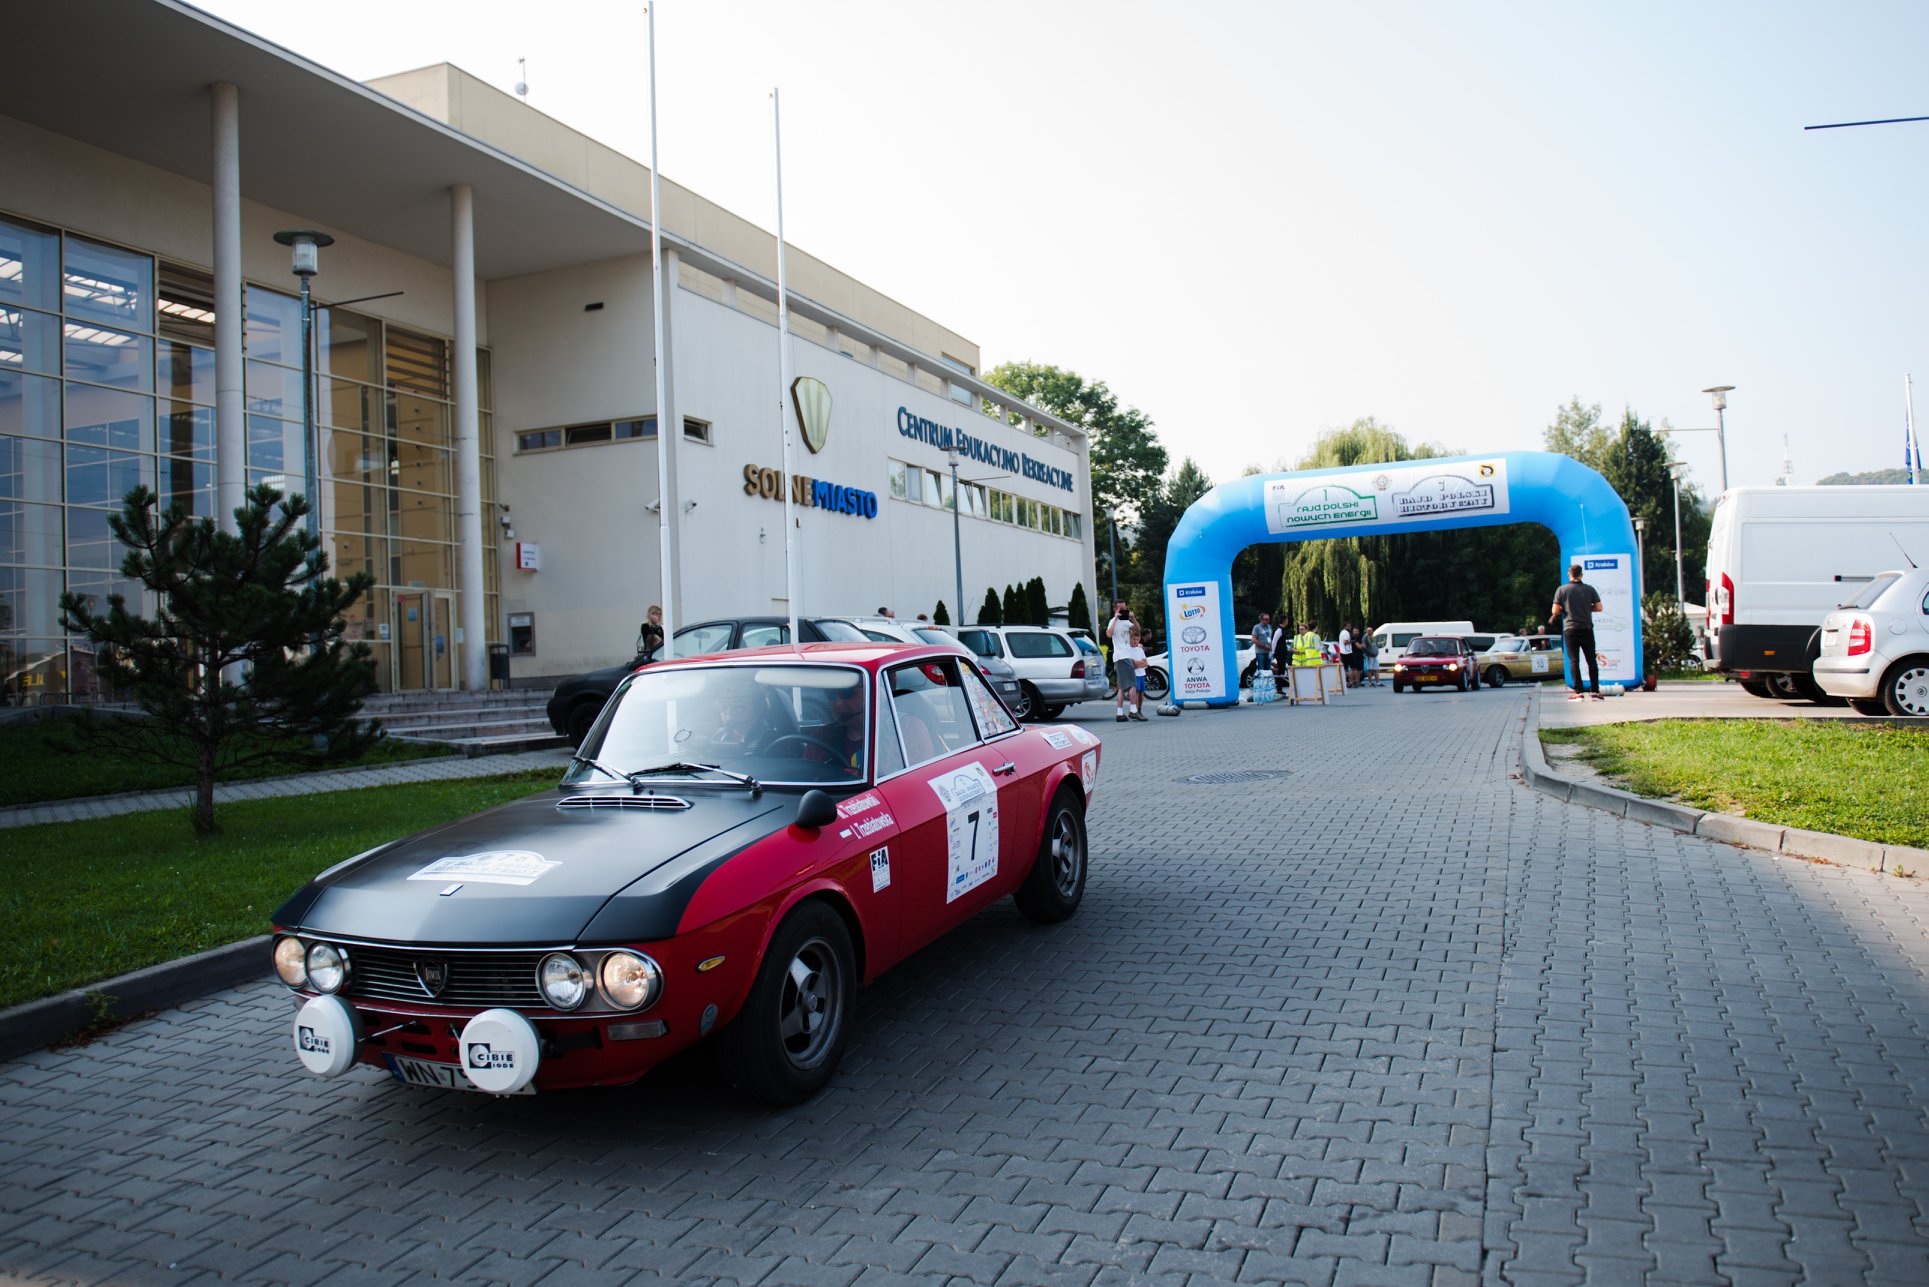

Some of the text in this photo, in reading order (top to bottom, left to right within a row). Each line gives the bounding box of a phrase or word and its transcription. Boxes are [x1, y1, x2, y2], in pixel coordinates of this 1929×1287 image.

[1184, 607, 1201, 618] LOTTO
[1180, 645, 1210, 653] TOYOTA
[967, 810, 980, 861] 7
[305, 1036, 329, 1048] CIBIE
[477, 1053, 513, 1062] CIBIE
[400, 1058, 442, 1086] WN
